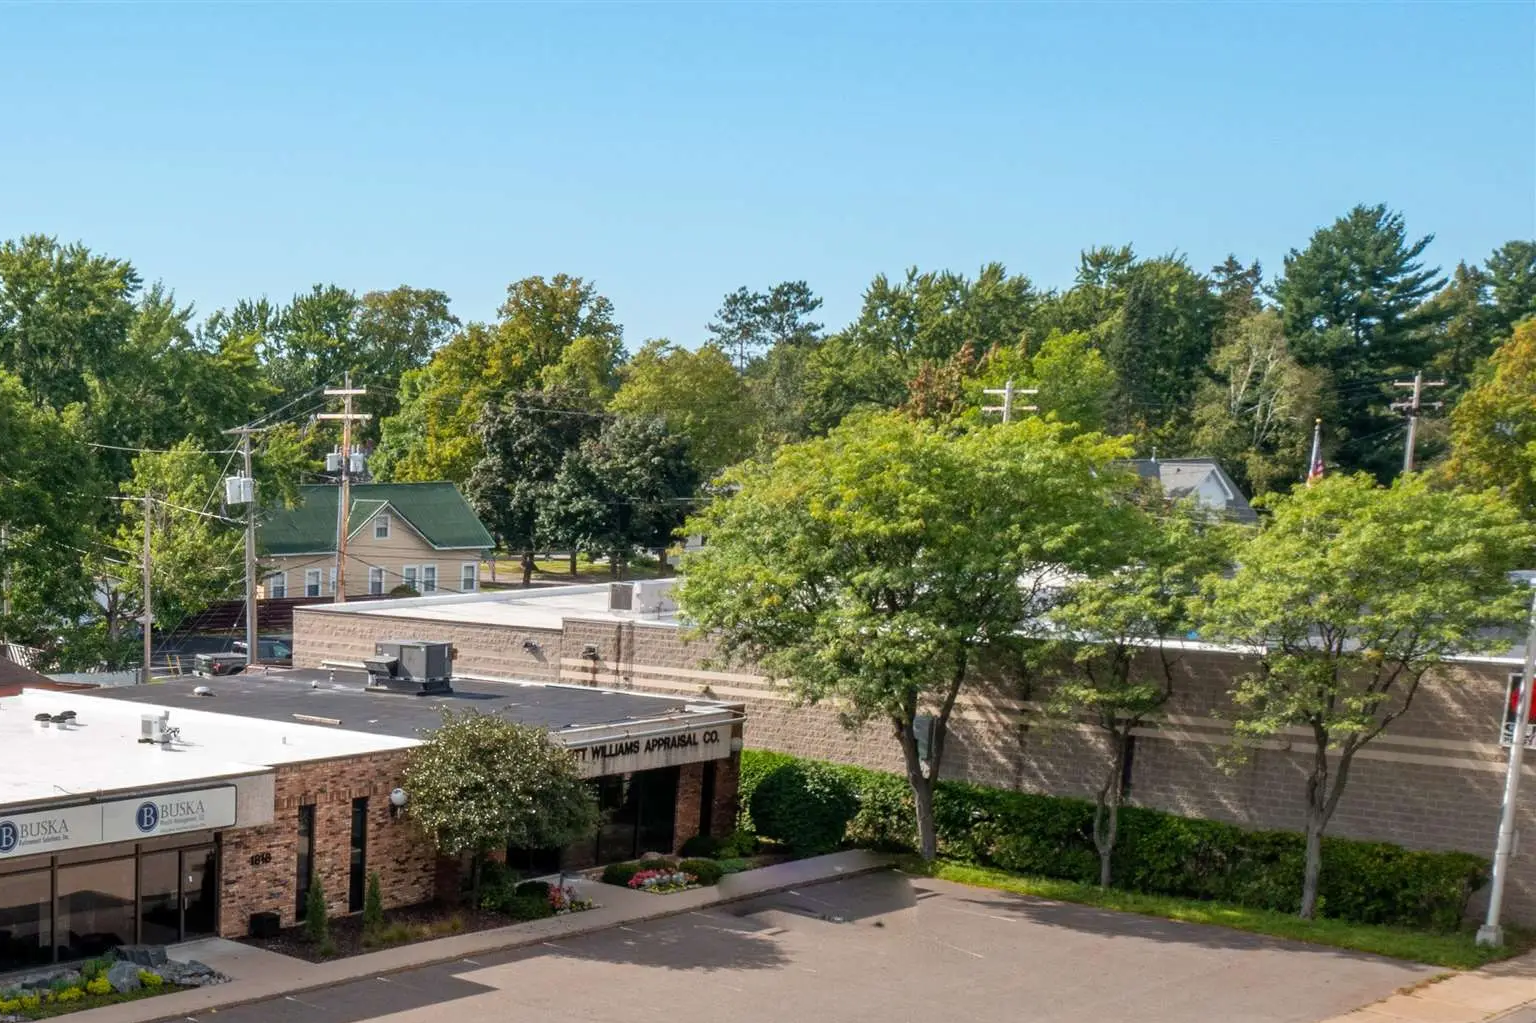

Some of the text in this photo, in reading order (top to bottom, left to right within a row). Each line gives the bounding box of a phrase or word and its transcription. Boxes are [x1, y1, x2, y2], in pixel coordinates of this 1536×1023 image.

[591, 740, 640, 759] WILLIAMS
[644, 734, 697, 752] APPRAISAL
[703, 731, 719, 744] CO.
[161, 800, 205, 818] BUSKA
[20, 819, 69, 838] BUSKA
